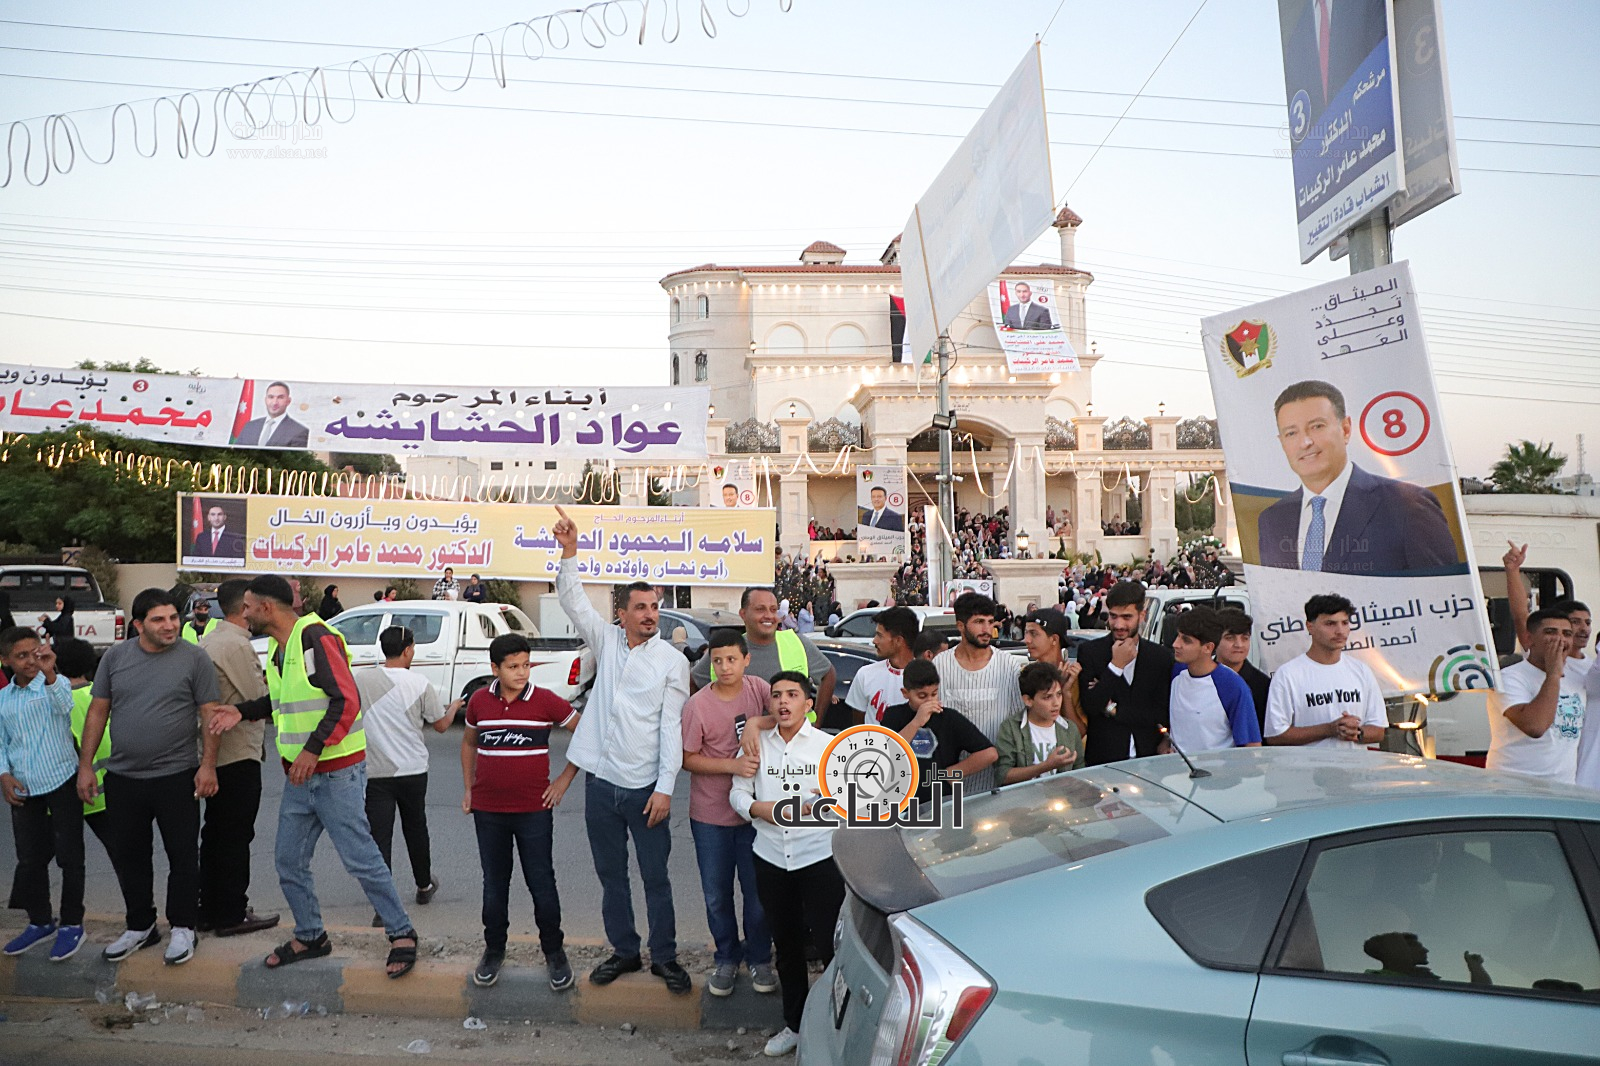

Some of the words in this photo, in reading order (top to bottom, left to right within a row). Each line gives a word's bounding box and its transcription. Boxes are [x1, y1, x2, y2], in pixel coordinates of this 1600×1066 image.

[1294, 99, 1306, 134] 3
[1320, 108, 1352, 156] الدكتور
[1360, 128, 1386, 160] محمد
[1336, 150, 1357, 183] عامر
[1356, 171, 1390, 210] الشباب
[1333, 196, 1355, 223] قادة
[1307, 213, 1333, 246] التغيير
[1317, 315, 1405, 346] وعلى
[23, 370, 108, 392] يؤيدون
[136, 381, 145, 391] 3
[79, 397, 212, 428] محمد
[525, 388, 607, 411] أبناء
[324, 409, 560, 450] الحشايشه
[576, 412, 682, 453] عواد
[1382, 408, 1407, 438] 8
[270, 508, 325, 527] الخال
[330, 506, 401, 531] ويأزرون
[406, 513, 478, 534] يؤيدون
[594, 514, 623, 524] الحاج
[252, 533, 329, 568] الركيبات
[331, 537, 371, 568] عامر
[377, 542, 423, 565] محمد
[427, 539, 491, 571] الدكتور
[609, 529, 692, 556] المحمود
[698, 531, 762, 554] سلامه
[606, 558, 649, 577] وأولاده
[1430, 594, 1475, 619] حزب
[1380, 626, 1417, 648] أحمد
[1306, 691, 1333, 707] New
[1335, 688, 1361, 705] York
